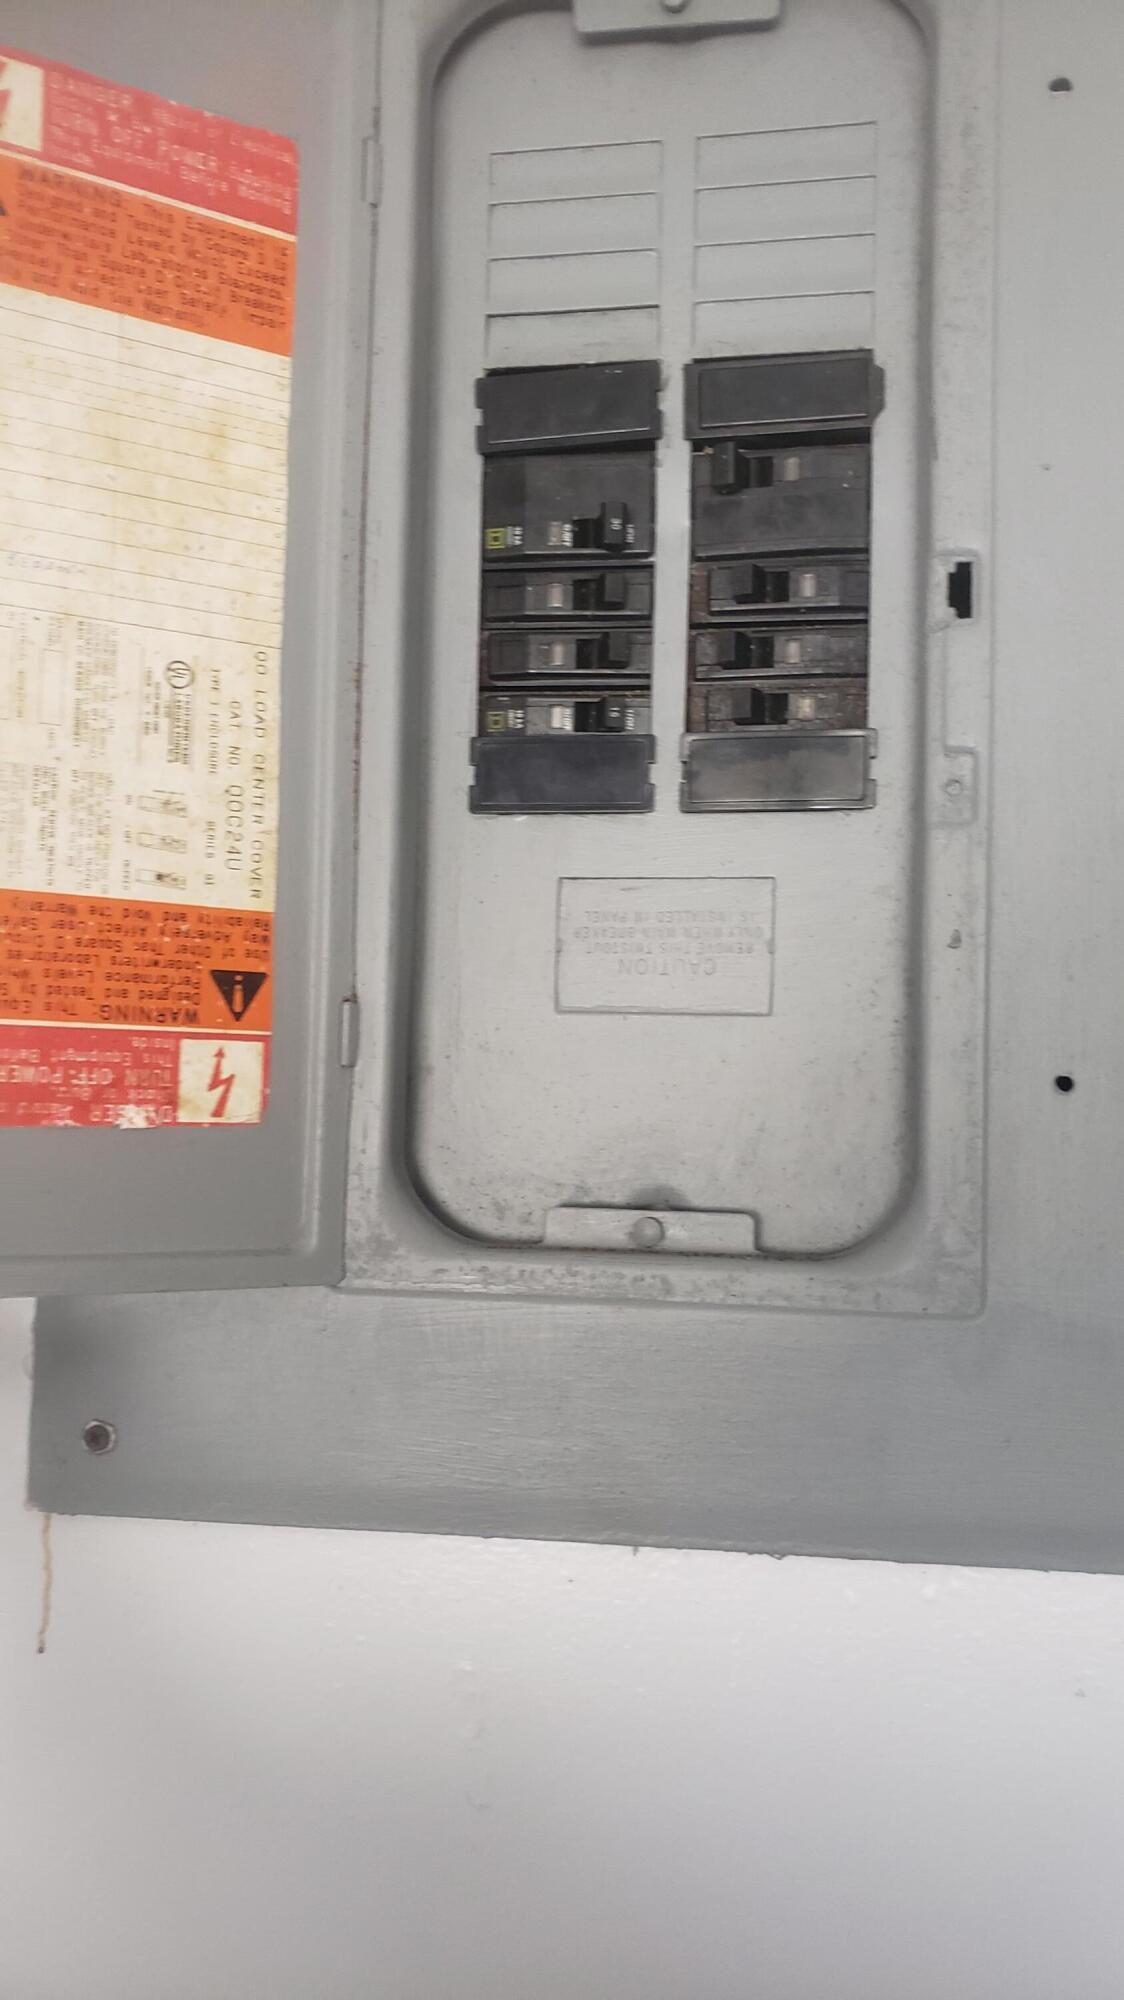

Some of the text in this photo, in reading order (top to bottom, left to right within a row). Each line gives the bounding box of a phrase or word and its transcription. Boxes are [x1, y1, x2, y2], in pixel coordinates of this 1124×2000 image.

[254, 690, 268, 738] LOAD
[252, 754, 266, 824] CENTER
[224, 785, 246, 871] QOC24U
[250, 840, 264, 899] COVER
[105, 972, 200, 990] Performance
[46, 985, 95, 1001] Tested
[104, 988, 129, 999] and
[139, 987, 200, 1006] Designed
[44, 1002, 78, 1017] This
[92, 1004, 200, 1025] WARNING:
